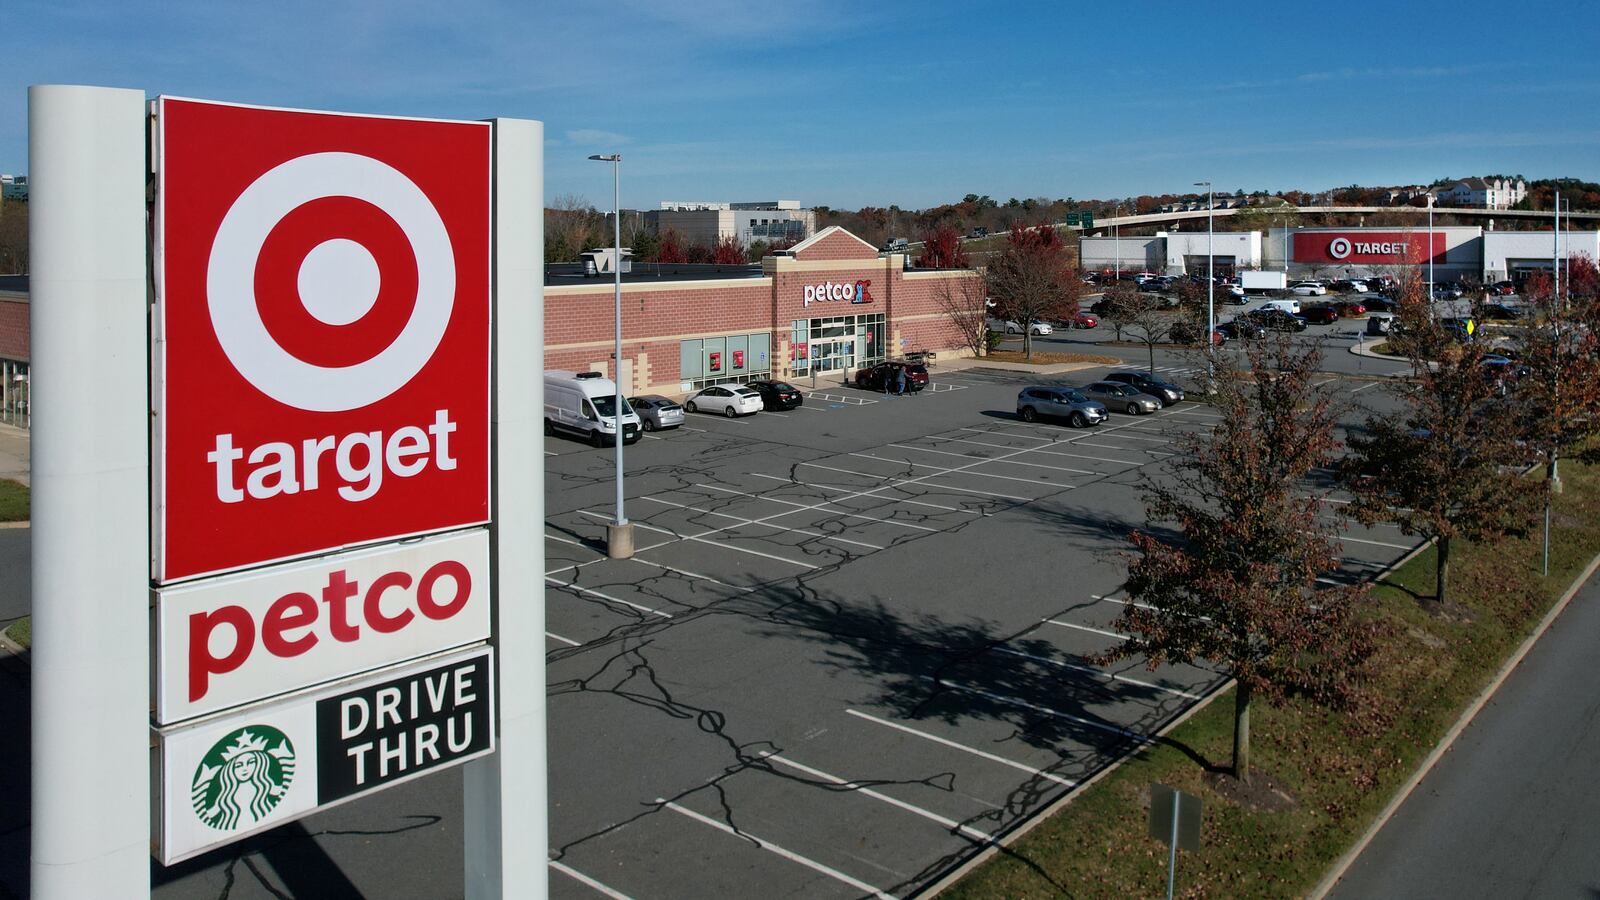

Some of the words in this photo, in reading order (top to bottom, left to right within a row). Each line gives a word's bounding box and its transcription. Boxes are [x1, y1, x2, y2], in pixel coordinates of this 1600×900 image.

[1355, 242, 1409, 254] TARGET
[804, 281, 854, 308] petco
[207, 409, 457, 504] target
[188, 560, 472, 703] petco
[341, 664, 477, 740] DRIVE
[347, 711, 473, 785] THRU
